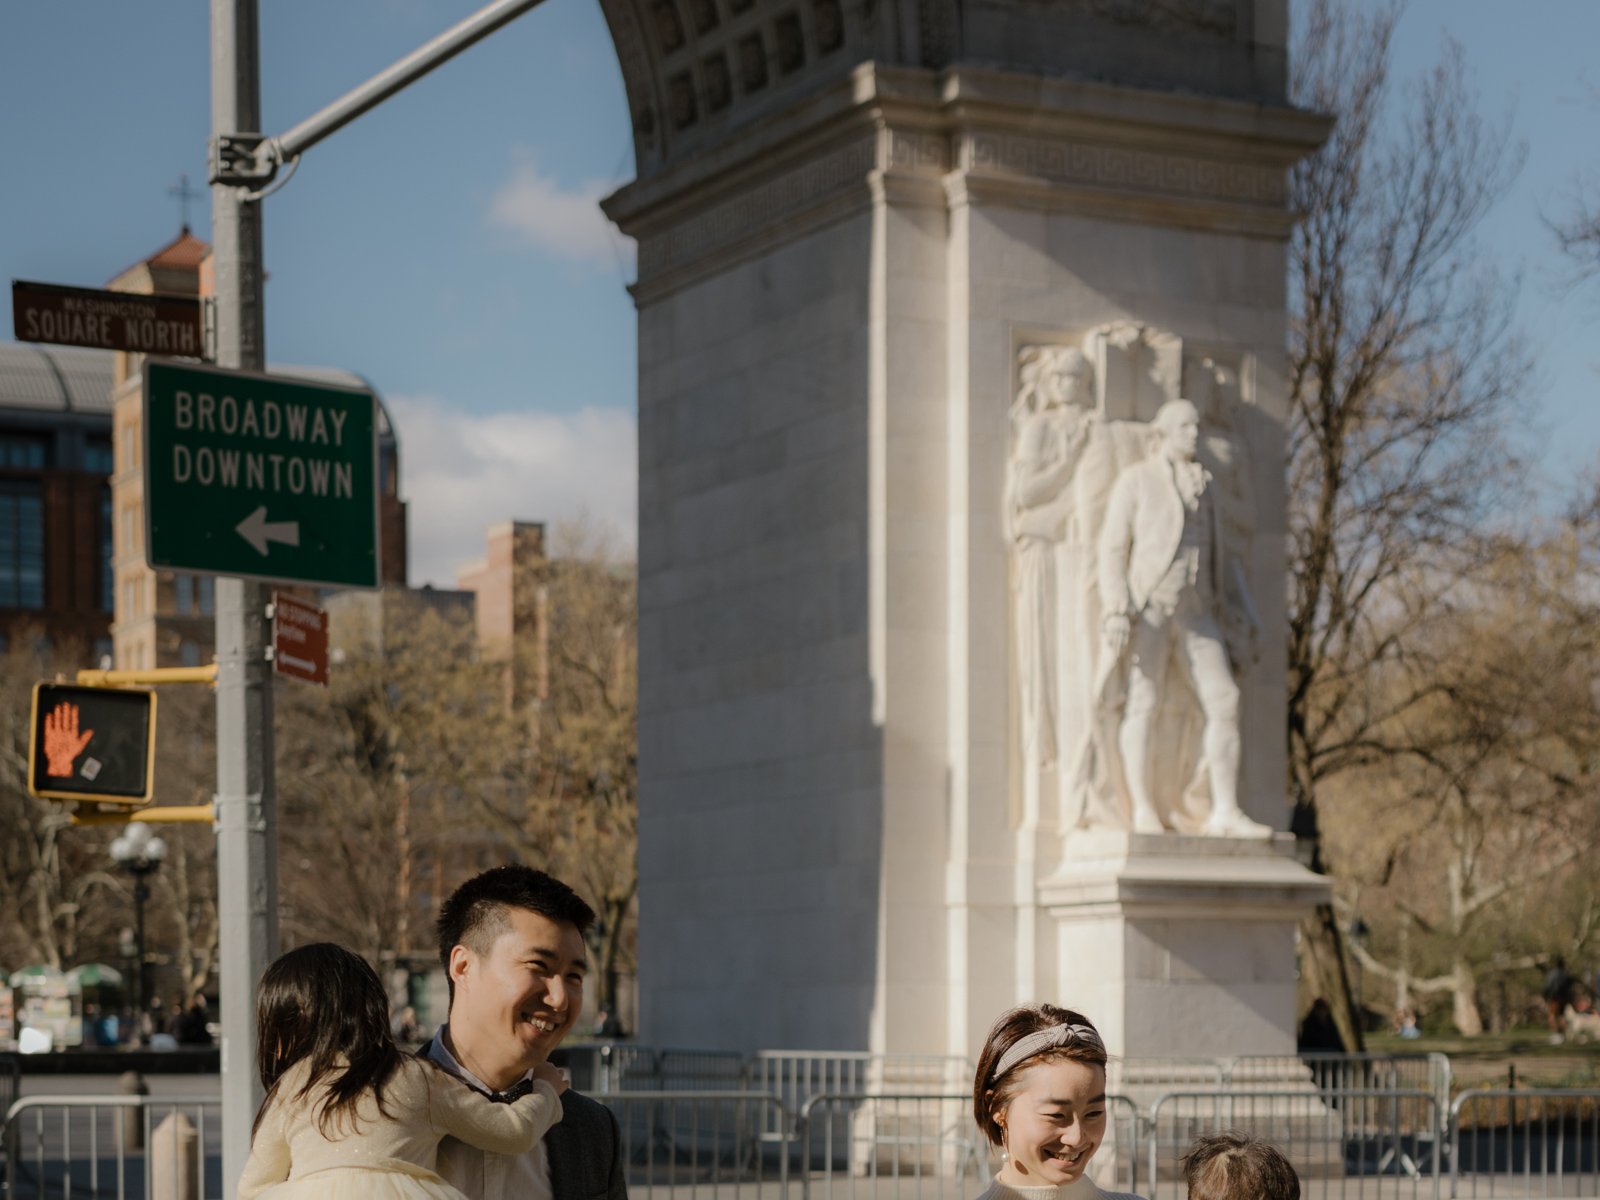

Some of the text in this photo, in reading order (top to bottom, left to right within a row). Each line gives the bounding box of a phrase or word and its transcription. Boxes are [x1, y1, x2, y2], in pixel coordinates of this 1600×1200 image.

[25, 308, 195, 351] SQUARE NORTH
[63, 297, 157, 319] WASHINGTON
[174, 390, 348, 447] BROADWAY
[172, 444, 354, 500] DOWNTOWN
